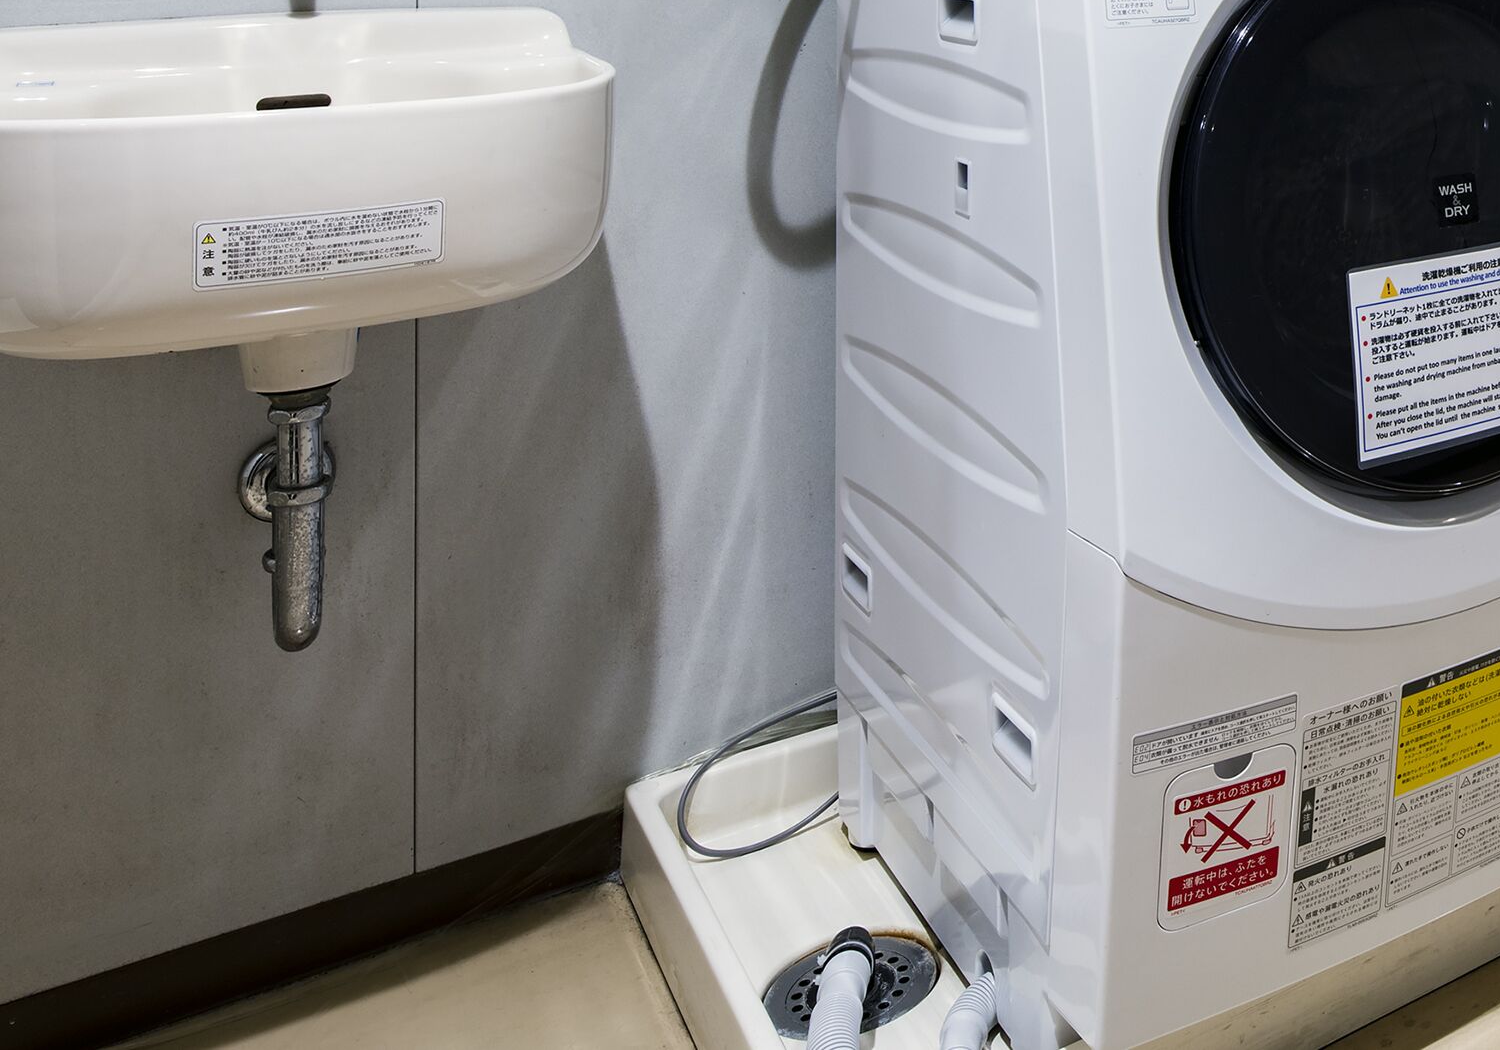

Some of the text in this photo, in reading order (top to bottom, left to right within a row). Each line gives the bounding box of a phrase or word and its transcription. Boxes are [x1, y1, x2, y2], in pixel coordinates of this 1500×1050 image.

[1438, 183, 1472, 197] WASH
[1452, 195, 1461, 206] &
[1445, 205, 1471, 218] DRY
[1400, 283, 1429, 295] Attention
[1438, 280, 1448, 288] use
[1450, 278, 1460, 286] the
[1460, 275, 1483, 285] washing
[1484, 271, 1495, 279] and
[1374, 371, 1394, 381] Please
[1417, 364, 1428, 372] put
[1429, 362, 1439, 370] too
[1441, 358, 1457, 367] many
[1458, 353, 1474, 362] items
[1375, 392, 1402, 402] damage.
[1310, 691, 1392, 725] オーナー様へのお願い
[1193, 776, 1282, 808] 水もれの恐れあり
[1323, 768, 1378, 794] 水漏れの恐れあり
[1182, 855, 1267, 890] 運転中は、ふたを
[1171, 870, 1275, 906] 開けないでください。
